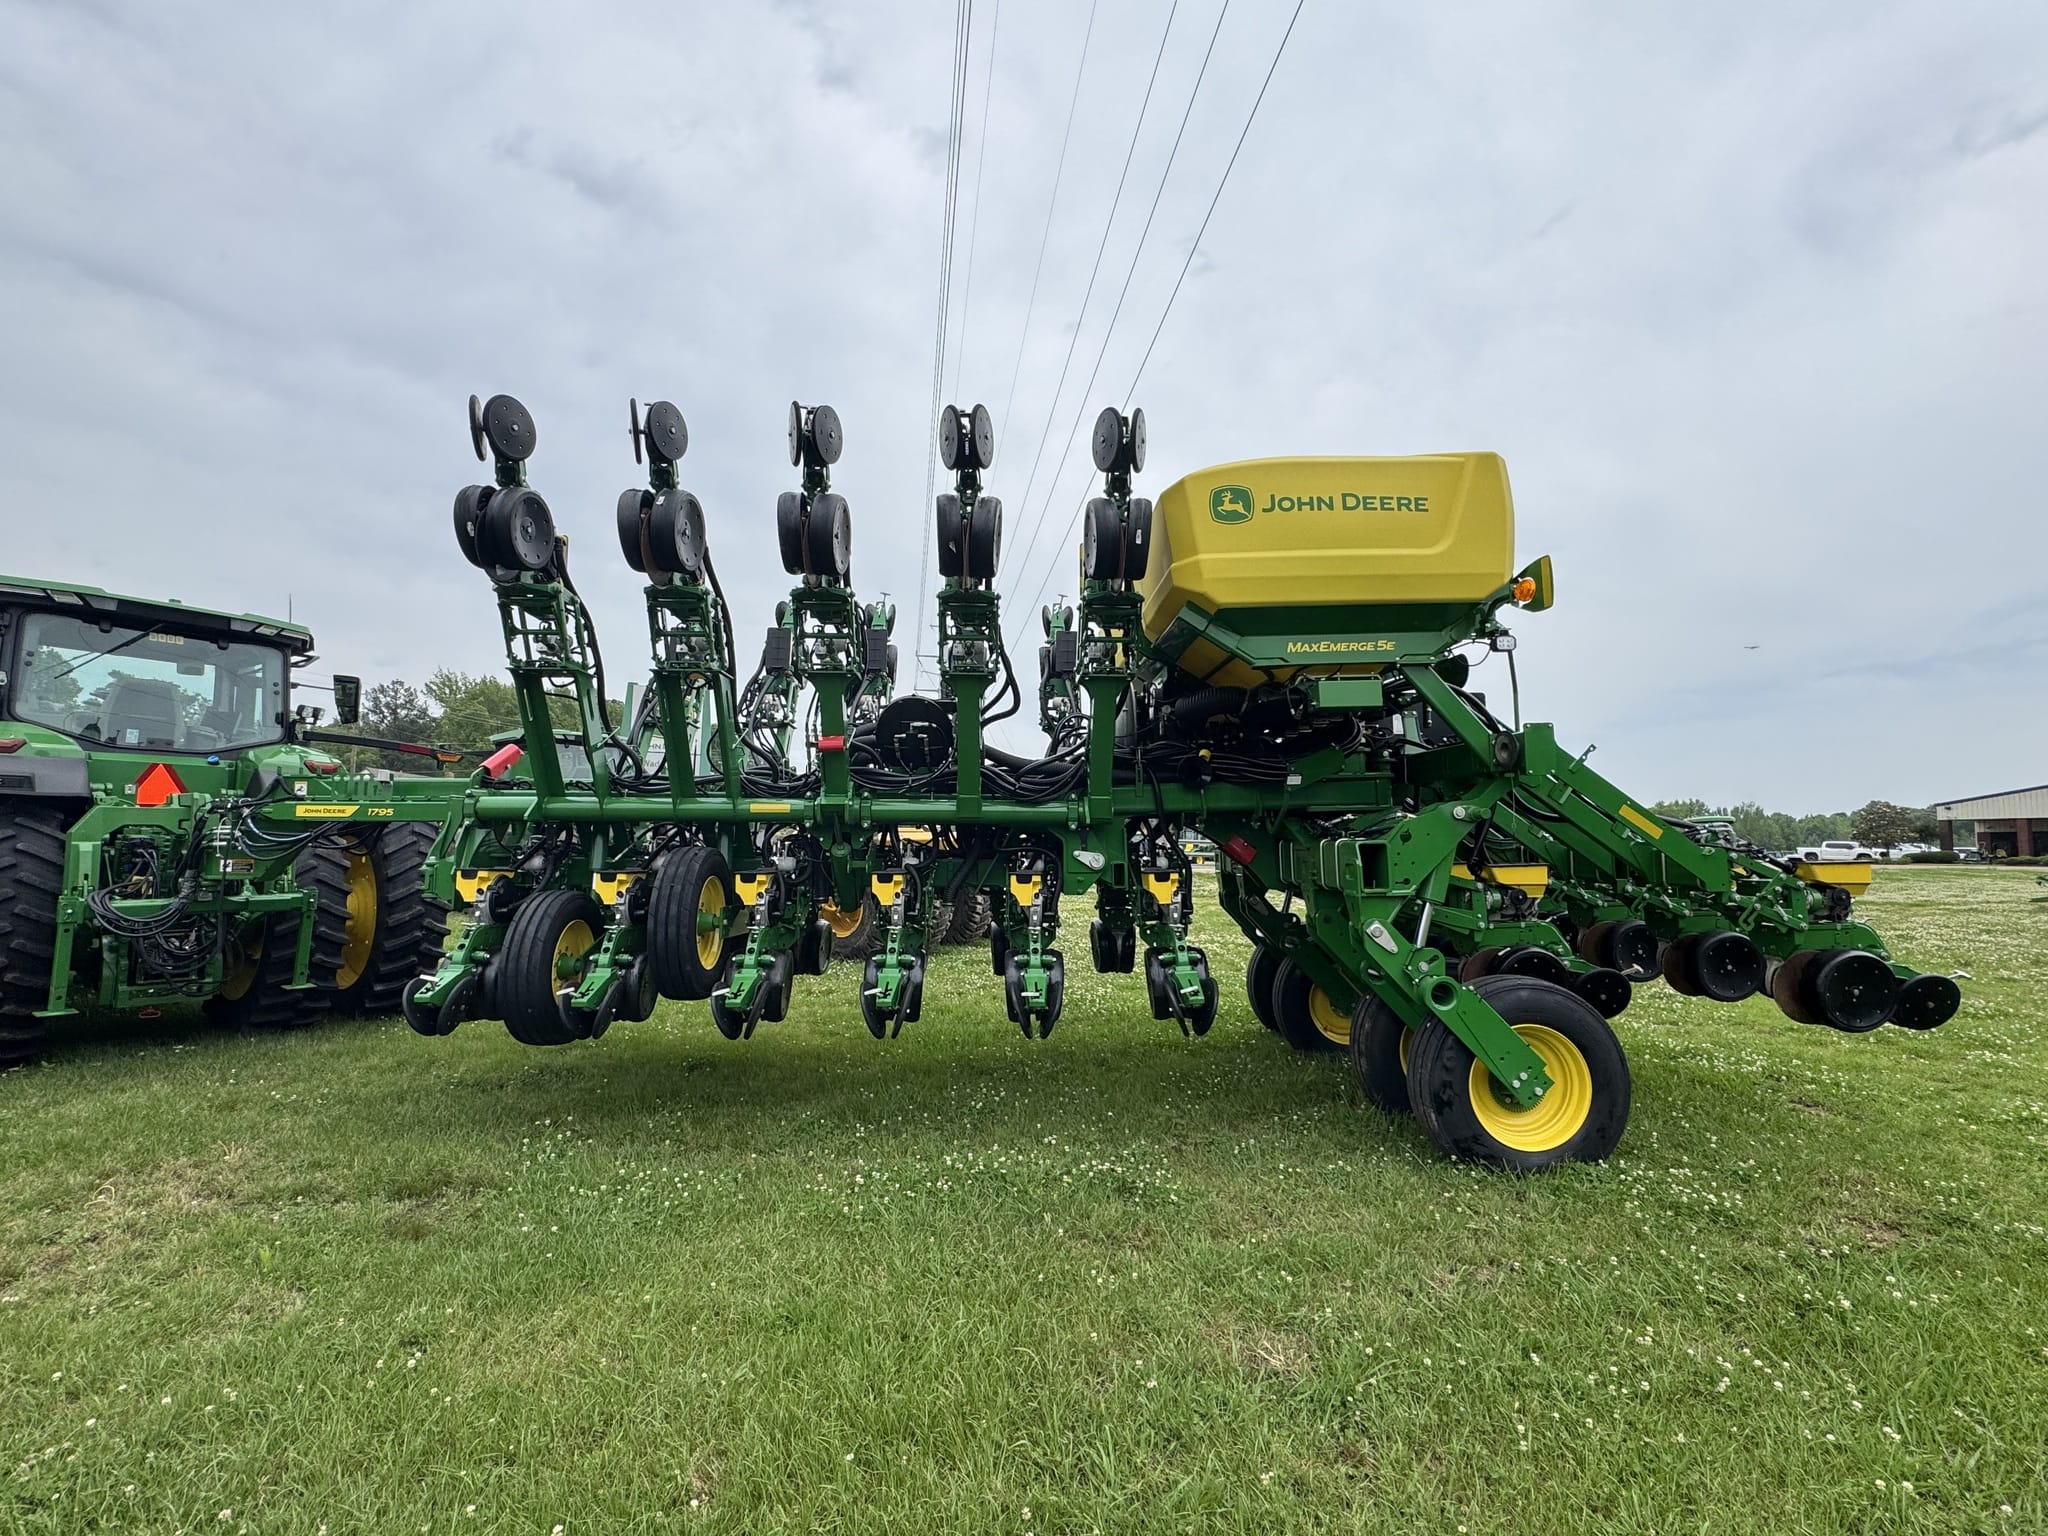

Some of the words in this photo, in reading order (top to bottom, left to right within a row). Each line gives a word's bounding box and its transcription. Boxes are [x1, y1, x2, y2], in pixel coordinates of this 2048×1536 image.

[1262, 494, 1334, 513] JOHN
[1341, 493, 1429, 512] DEERE
[367, 808, 395, 816] 1795
